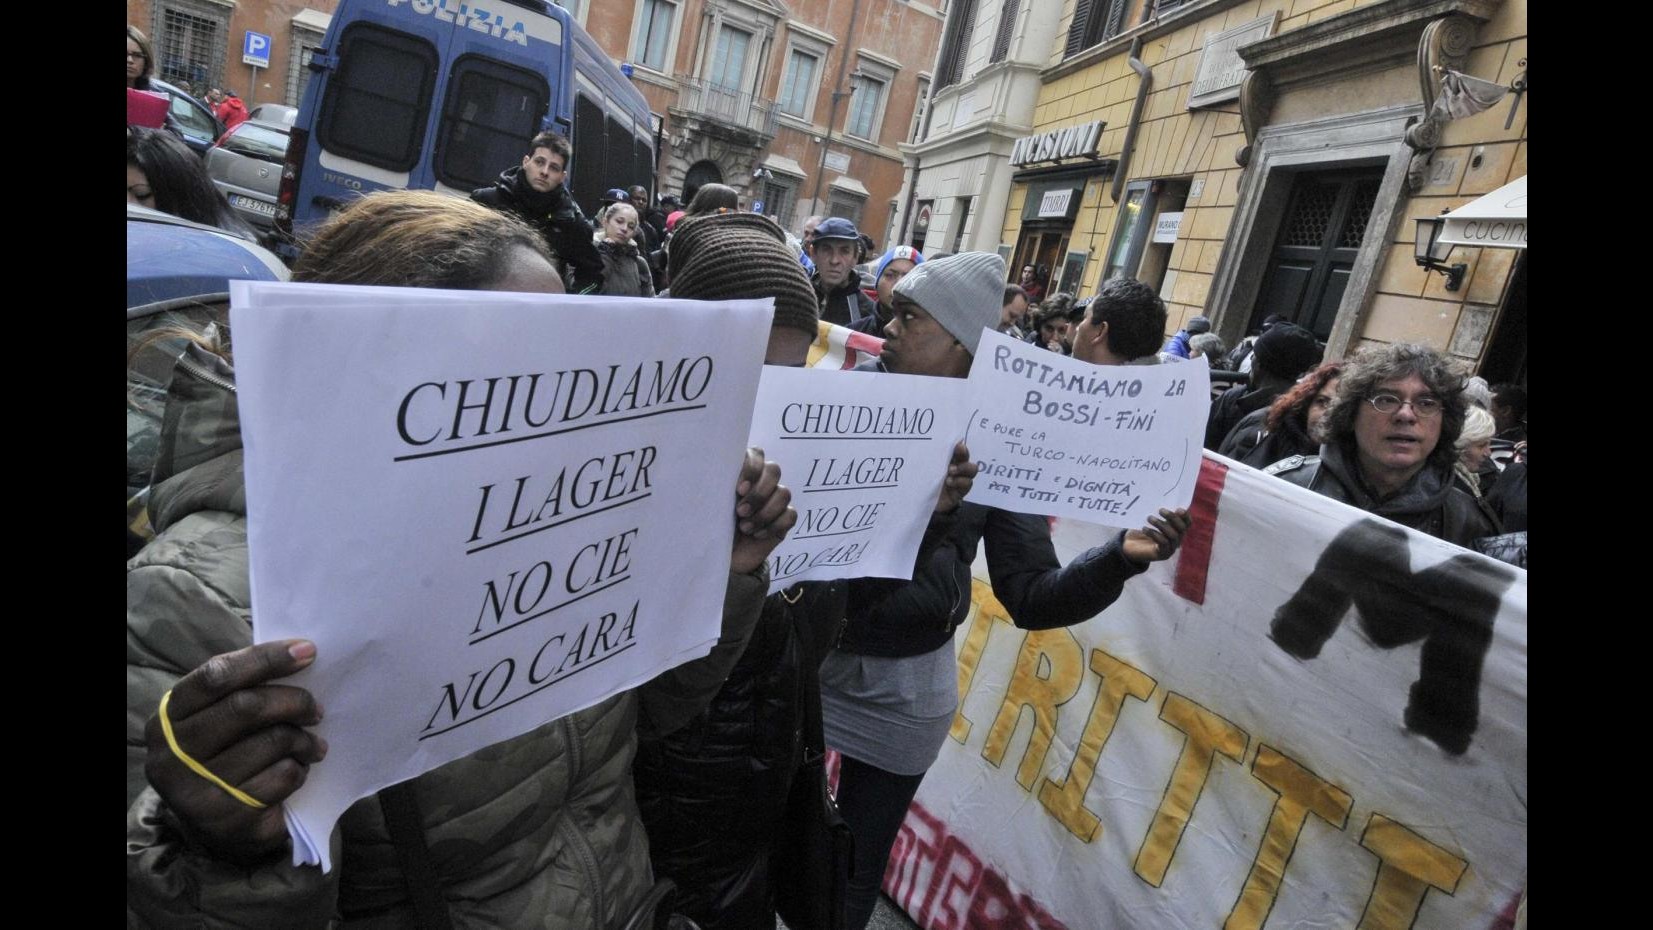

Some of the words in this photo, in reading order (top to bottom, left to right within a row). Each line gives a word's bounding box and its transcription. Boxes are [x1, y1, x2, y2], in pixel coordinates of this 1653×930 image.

[249, 34, 266, 54] P
[1008, 119, 1104, 167] INCISIONI
[322, 171, 363, 191] IVECO
[1040, 194, 1070, 213] TIMBRI
[1463, 220, 1527, 242] cucin
[396, 355, 714, 447] CHIUDIAMO
[1164, 379, 1187, 397] LA
[781, 402, 935, 435] CHIUDIAMO
[993, 422, 1024, 438] PURE
[1031, 431, 1047, 441] LA
[804, 458, 821, 488] I
[821, 456, 905, 487] LAGER
[976, 458, 1043, 482] DIRITTI
[465, 483, 497, 545] I
[501, 445, 658, 533] LAGER
[988, 480, 1011, 495] PER
[1017, 485, 1061, 503] TUTTI
[1078, 494, 1141, 516] TUTTE!
[795, 506, 840, 535] NO
[841, 502, 887, 529] CIE
[770, 552, 809, 577] NO
[808, 540, 871, 568] CARA
[469, 560, 553, 636] NO
[564, 527, 640, 594] CIE
[420, 657, 516, 733] NO
[528, 598, 641, 686] CARA
[948, 576, 1469, 930] IRITTI
